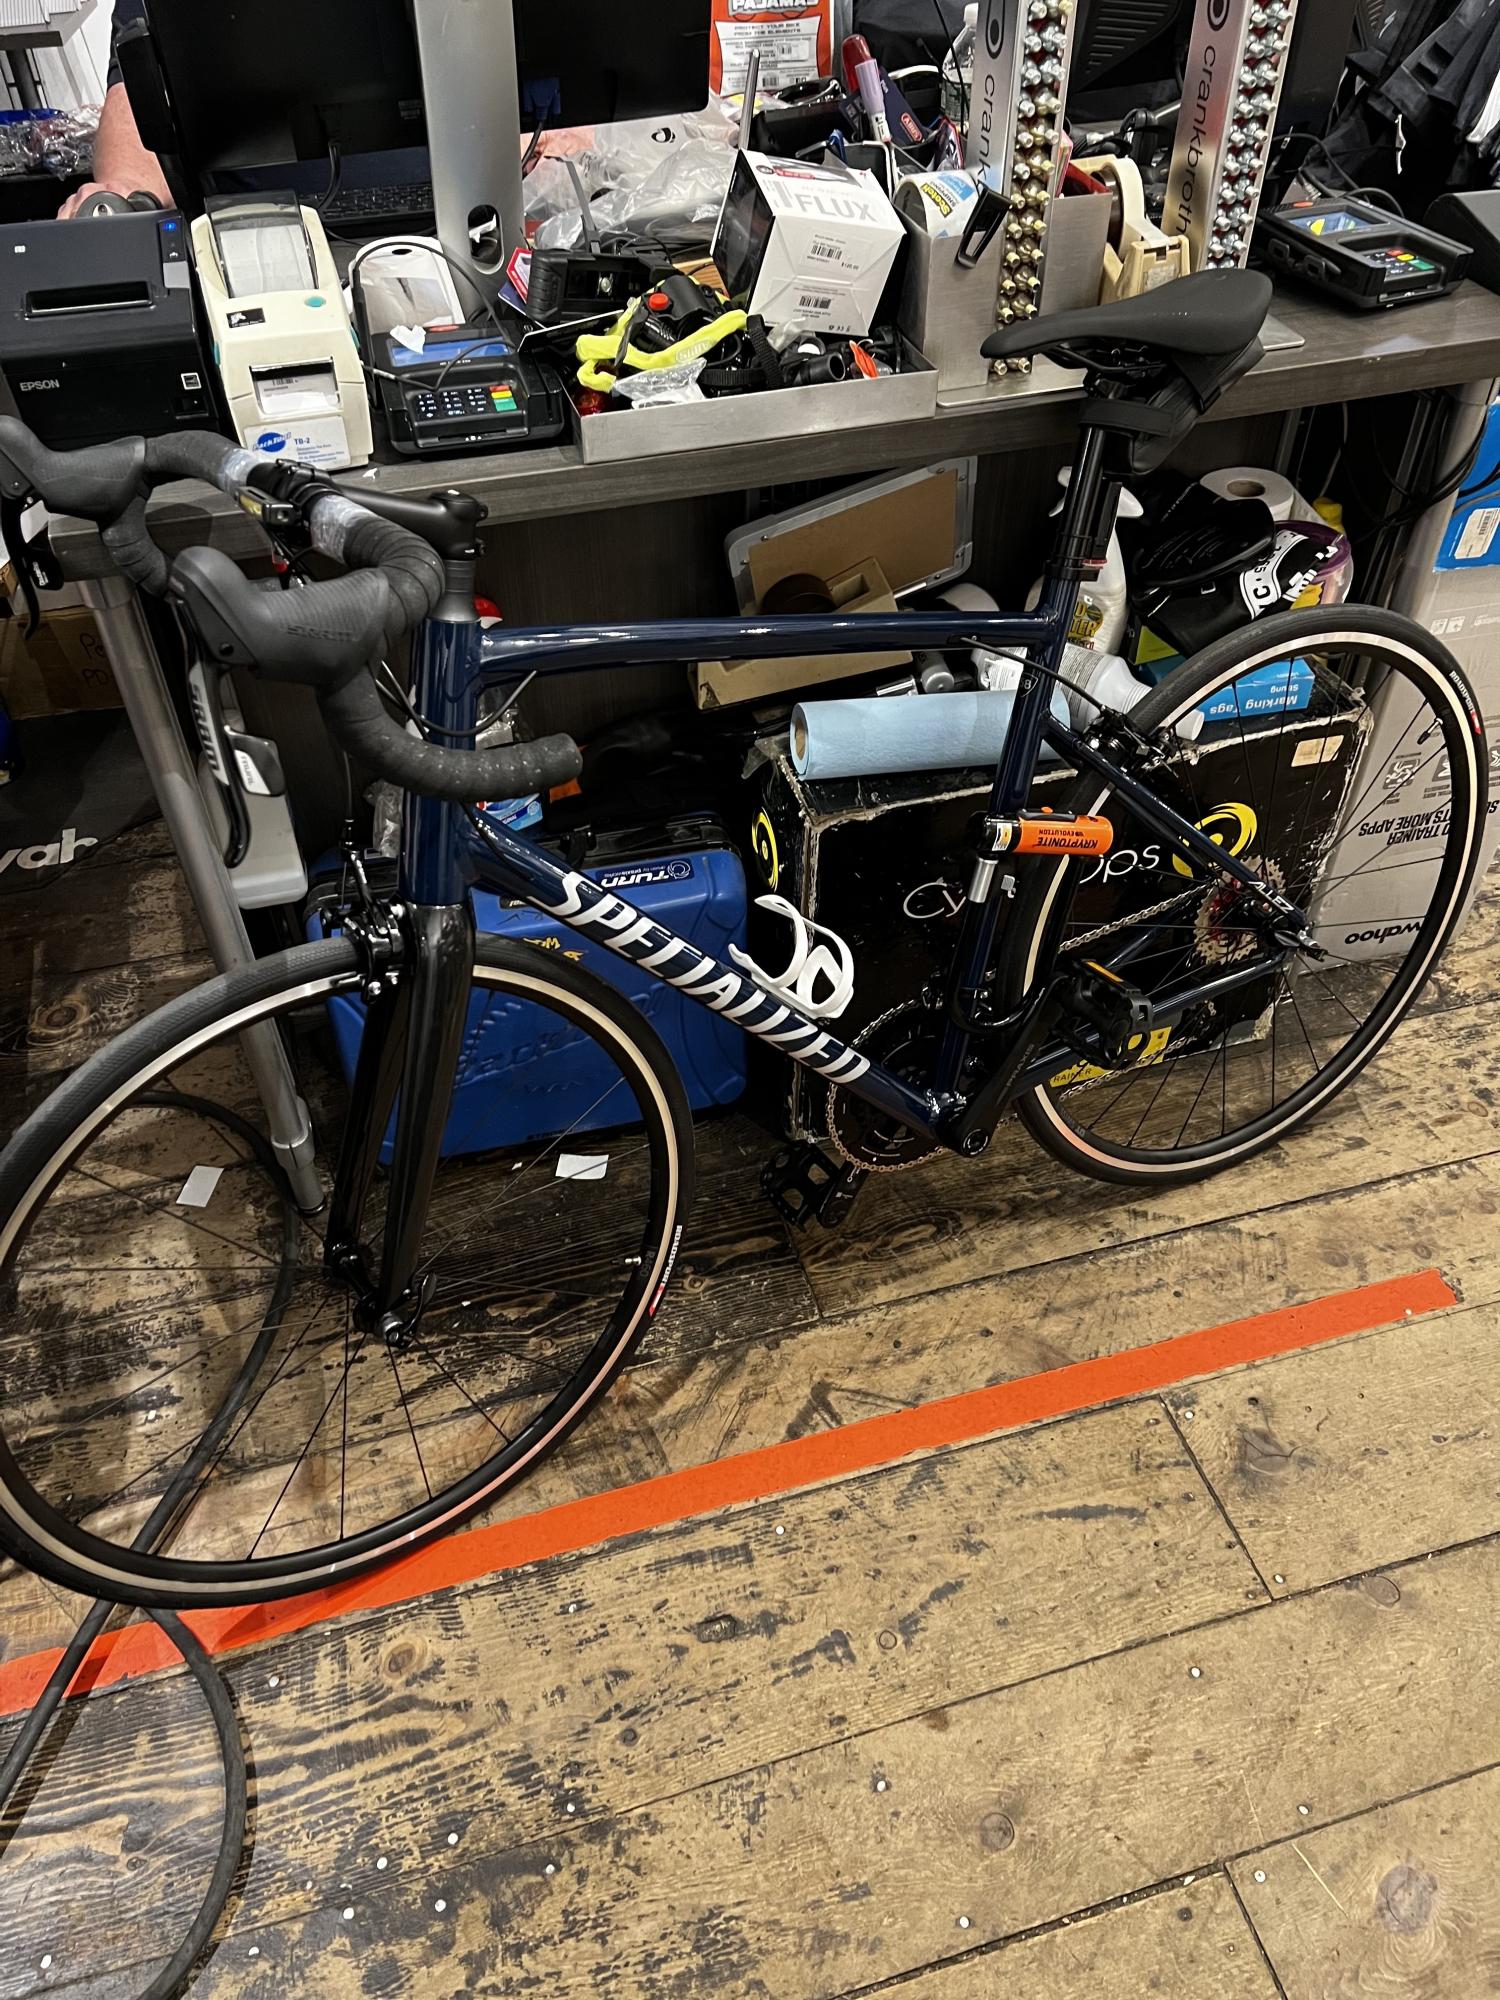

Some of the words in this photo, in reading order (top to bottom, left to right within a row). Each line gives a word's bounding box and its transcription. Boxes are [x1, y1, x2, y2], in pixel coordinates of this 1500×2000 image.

[794, 193, 878, 223] FLUX
[921, 183, 952, 217] Scotch
[19, 379, 60, 392] EPSON
[1245, 694, 1298, 710] Marking
[1449, 670, 1475, 712] ROADSPORT
[1209, 702, 1240, 715] Tags
[1358, 818, 1396, 837] APPS
[1394, 810, 1435, 829] MORE
[1036, 837, 1098, 848] KRYPTONITE
[1386, 823, 1440, 846] TRAINER
[600, 870, 670, 888] TURN
[1247, 880, 1295, 914] ALLEZ
[1344, 921, 1422, 945] wahoo
[529, 871, 871, 1084] SPECIALIZED
[660, 1225, 683, 1286] ROADSPORT
